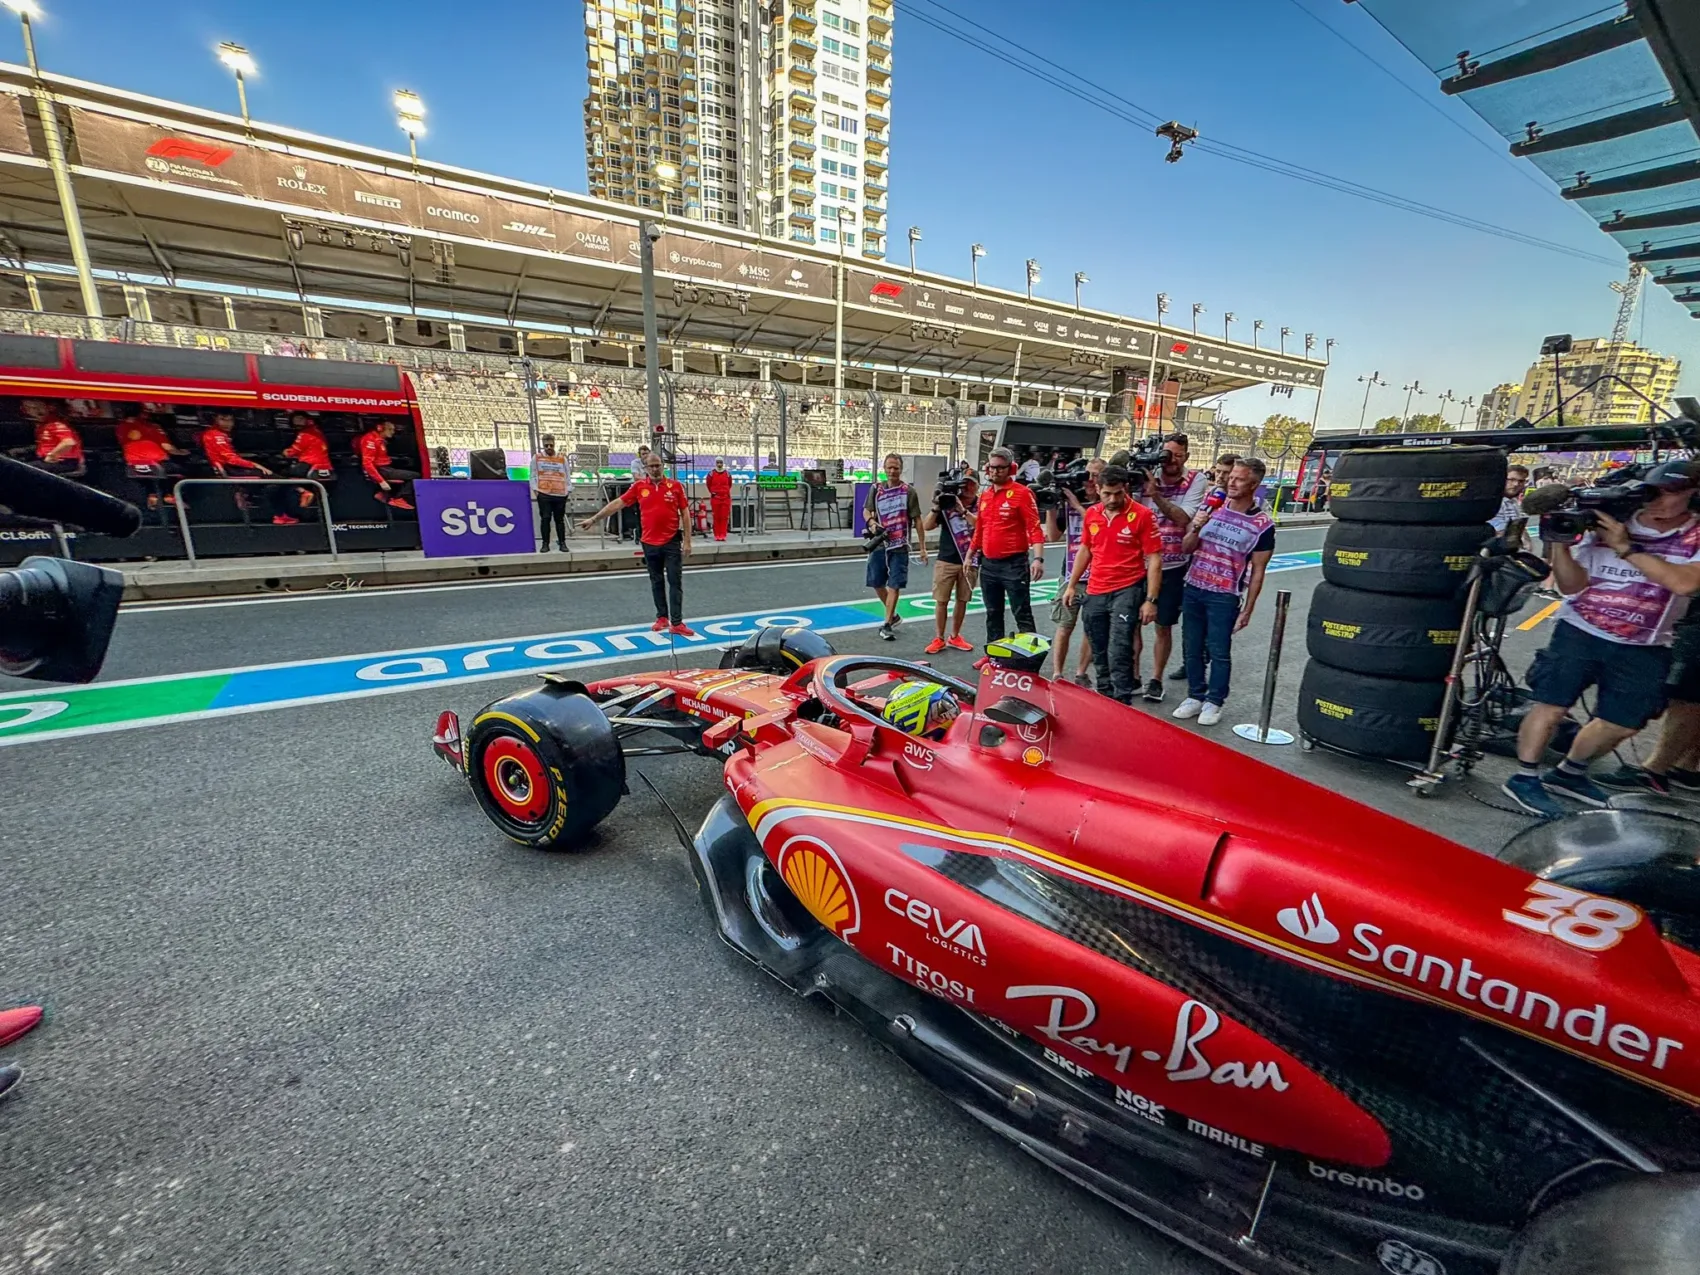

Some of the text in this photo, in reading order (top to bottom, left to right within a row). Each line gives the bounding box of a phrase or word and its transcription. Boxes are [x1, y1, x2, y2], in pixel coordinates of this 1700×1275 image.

[276, 176, 328, 196] ROLEX
[426, 206, 480, 224] aramco
[502, 221, 556, 238] DHL
[575, 231, 610, 247] QATAR
[584, 242, 611, 253] AIRWAYS
[681, 255, 723, 271] crypto.com
[749, 264, 770, 278] MSC
[916, 300, 936, 310] ROLEX
[262, 393, 327, 404] SCUDERIA
[327, 397, 378, 406] FERRARI
[1402, 438, 1452, 446] Einhell
[441, 501, 516, 536] stc
[1322, 620, 1362, 634] POSTERIORE
[355, 615, 813, 682] aramco
[991, 669, 1033, 692] ZCG
[677, 696, 712, 714] RICHARD
[1315, 699, 1354, 716] POSTERIORE
[904, 740, 934, 762] aws
[548, 766, 568, 840] P ZERO
[1502, 879, 1643, 950] 38
[925, 932, 988, 968] LOGISTICS
[885, 941, 975, 1004] TIFOSI
[1347, 922, 1684, 1070] Santander
[1005, 985, 1290, 1093] Ray-Ban
[1043, 1047, 1095, 1079] SKF
[1115, 1084, 1166, 1119] NGK
[1115, 1099, 1165, 1127] SPARK PLUGS
[1187, 1118, 1265, 1158] MAHLE
[1307, 1160, 1425, 1201] brembo
